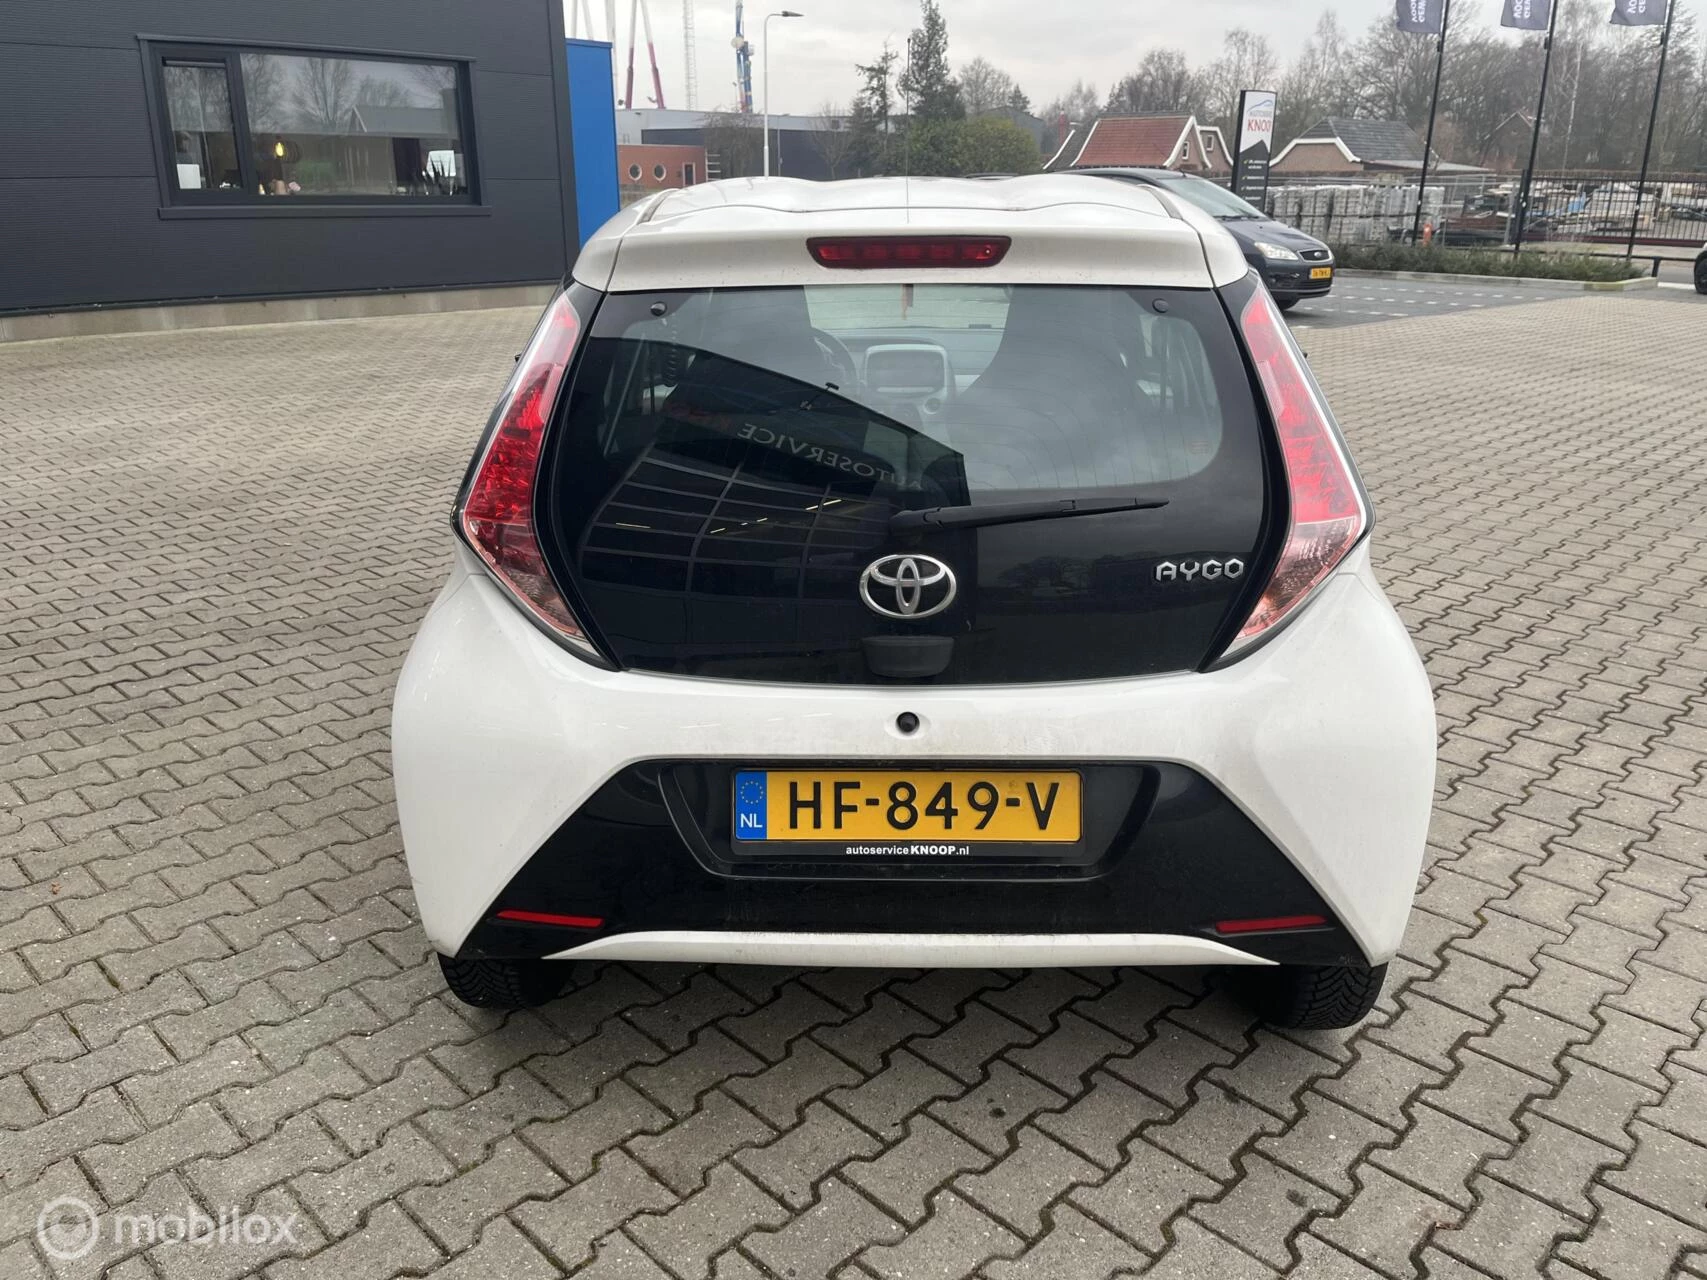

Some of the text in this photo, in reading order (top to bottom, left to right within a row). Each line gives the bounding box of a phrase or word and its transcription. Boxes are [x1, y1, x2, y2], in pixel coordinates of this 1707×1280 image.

[1156, 558, 1244, 581] AYGO
[789, 781, 1060, 830] HF-849-V
[740, 813, 763, 829] NL
